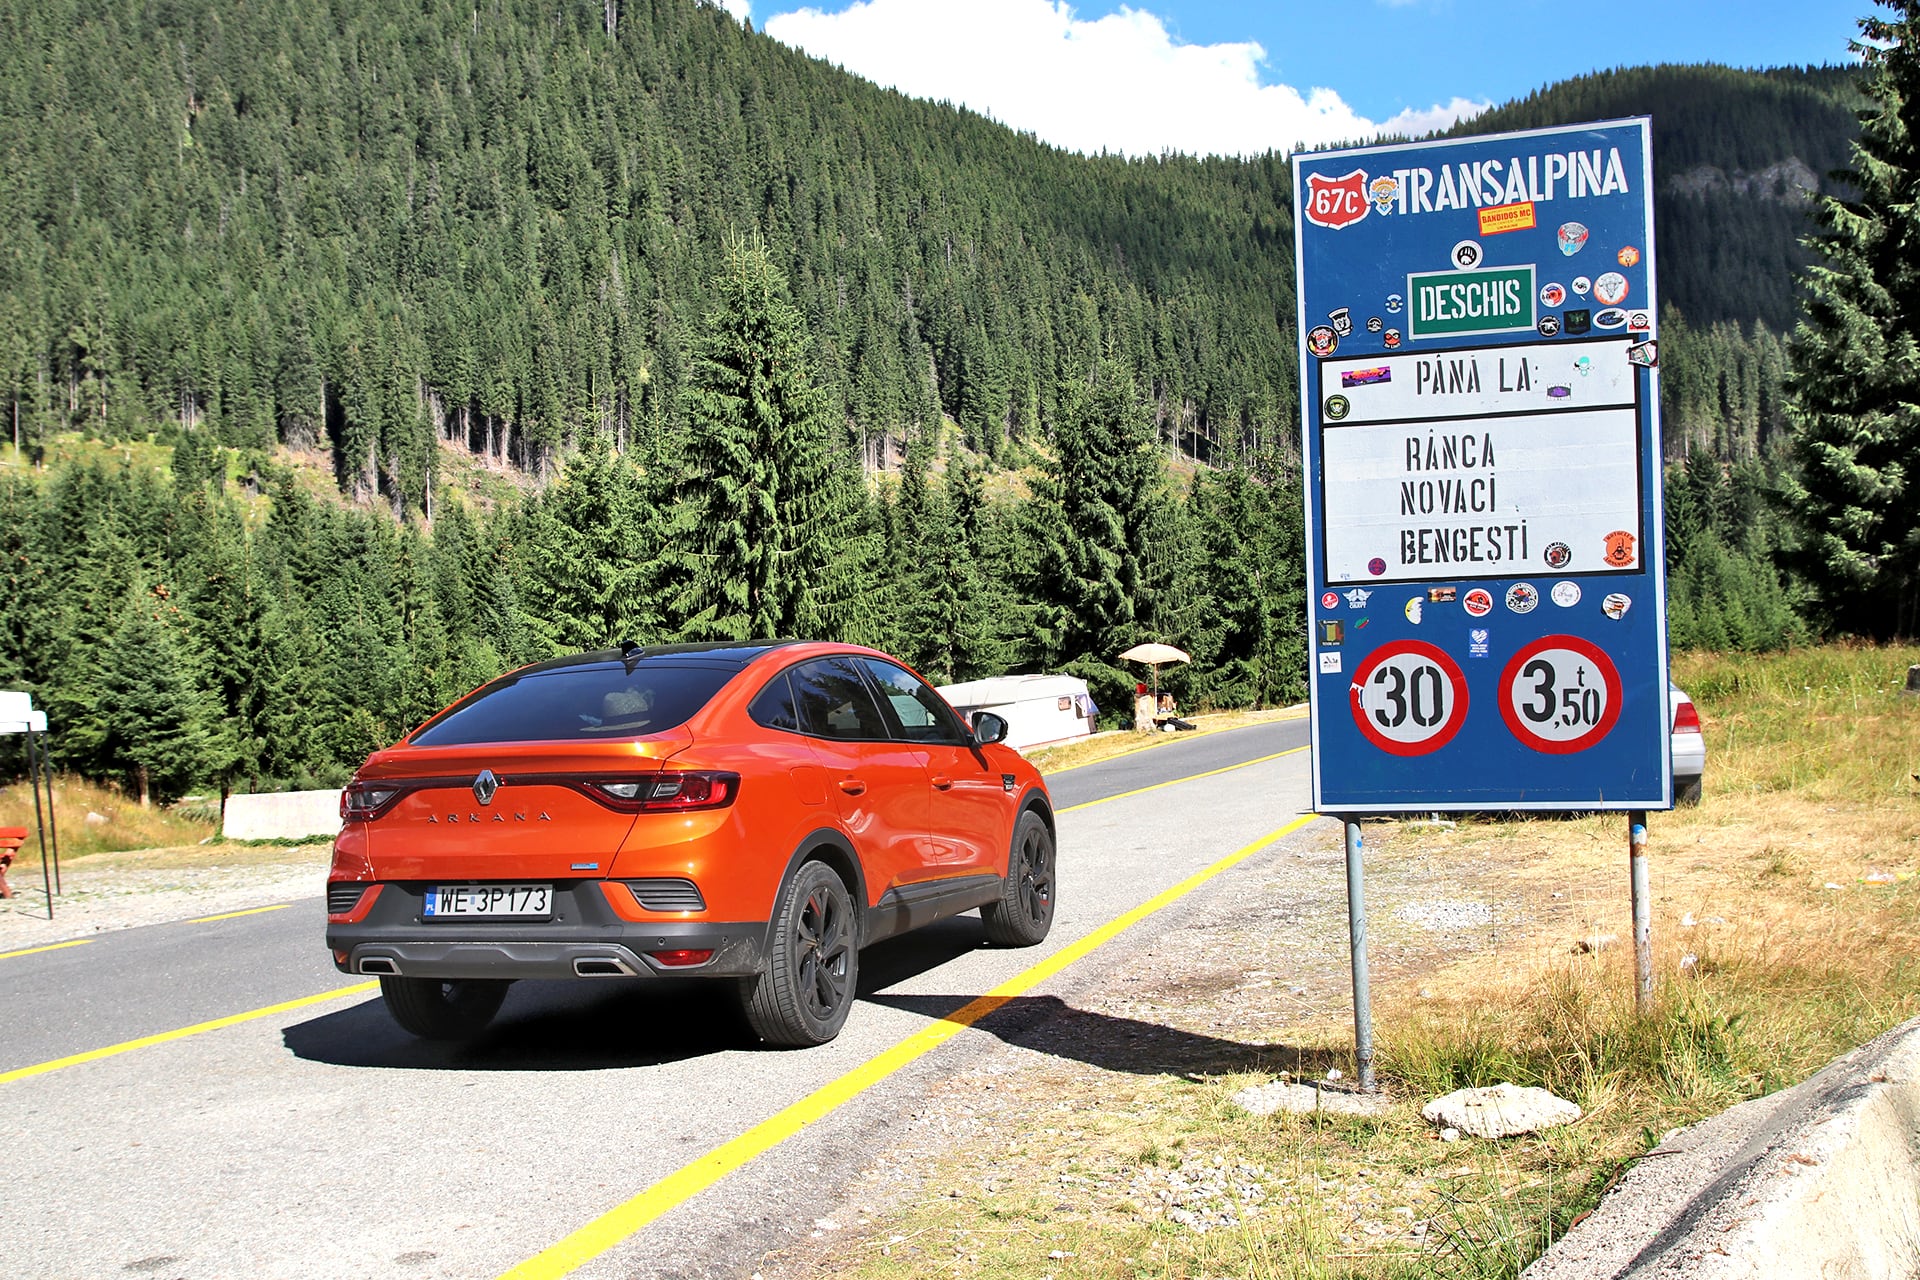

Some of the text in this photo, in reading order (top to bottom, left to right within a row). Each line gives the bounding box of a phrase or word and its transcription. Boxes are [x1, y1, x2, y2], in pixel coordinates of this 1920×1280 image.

[1393, 147, 1629, 215] TRANSALPINA
[1316, 188, 1359, 215] 67C
[1481, 210, 1519, 224] BANDIDOS
[1519, 208, 1531, 218] MC
[1420, 279, 1521, 321] DESCHIS
[1374, 665, 1444, 728] 30
[427, 811, 552, 824] ARKANA
[440, 886, 548, 913] WE 3P173
